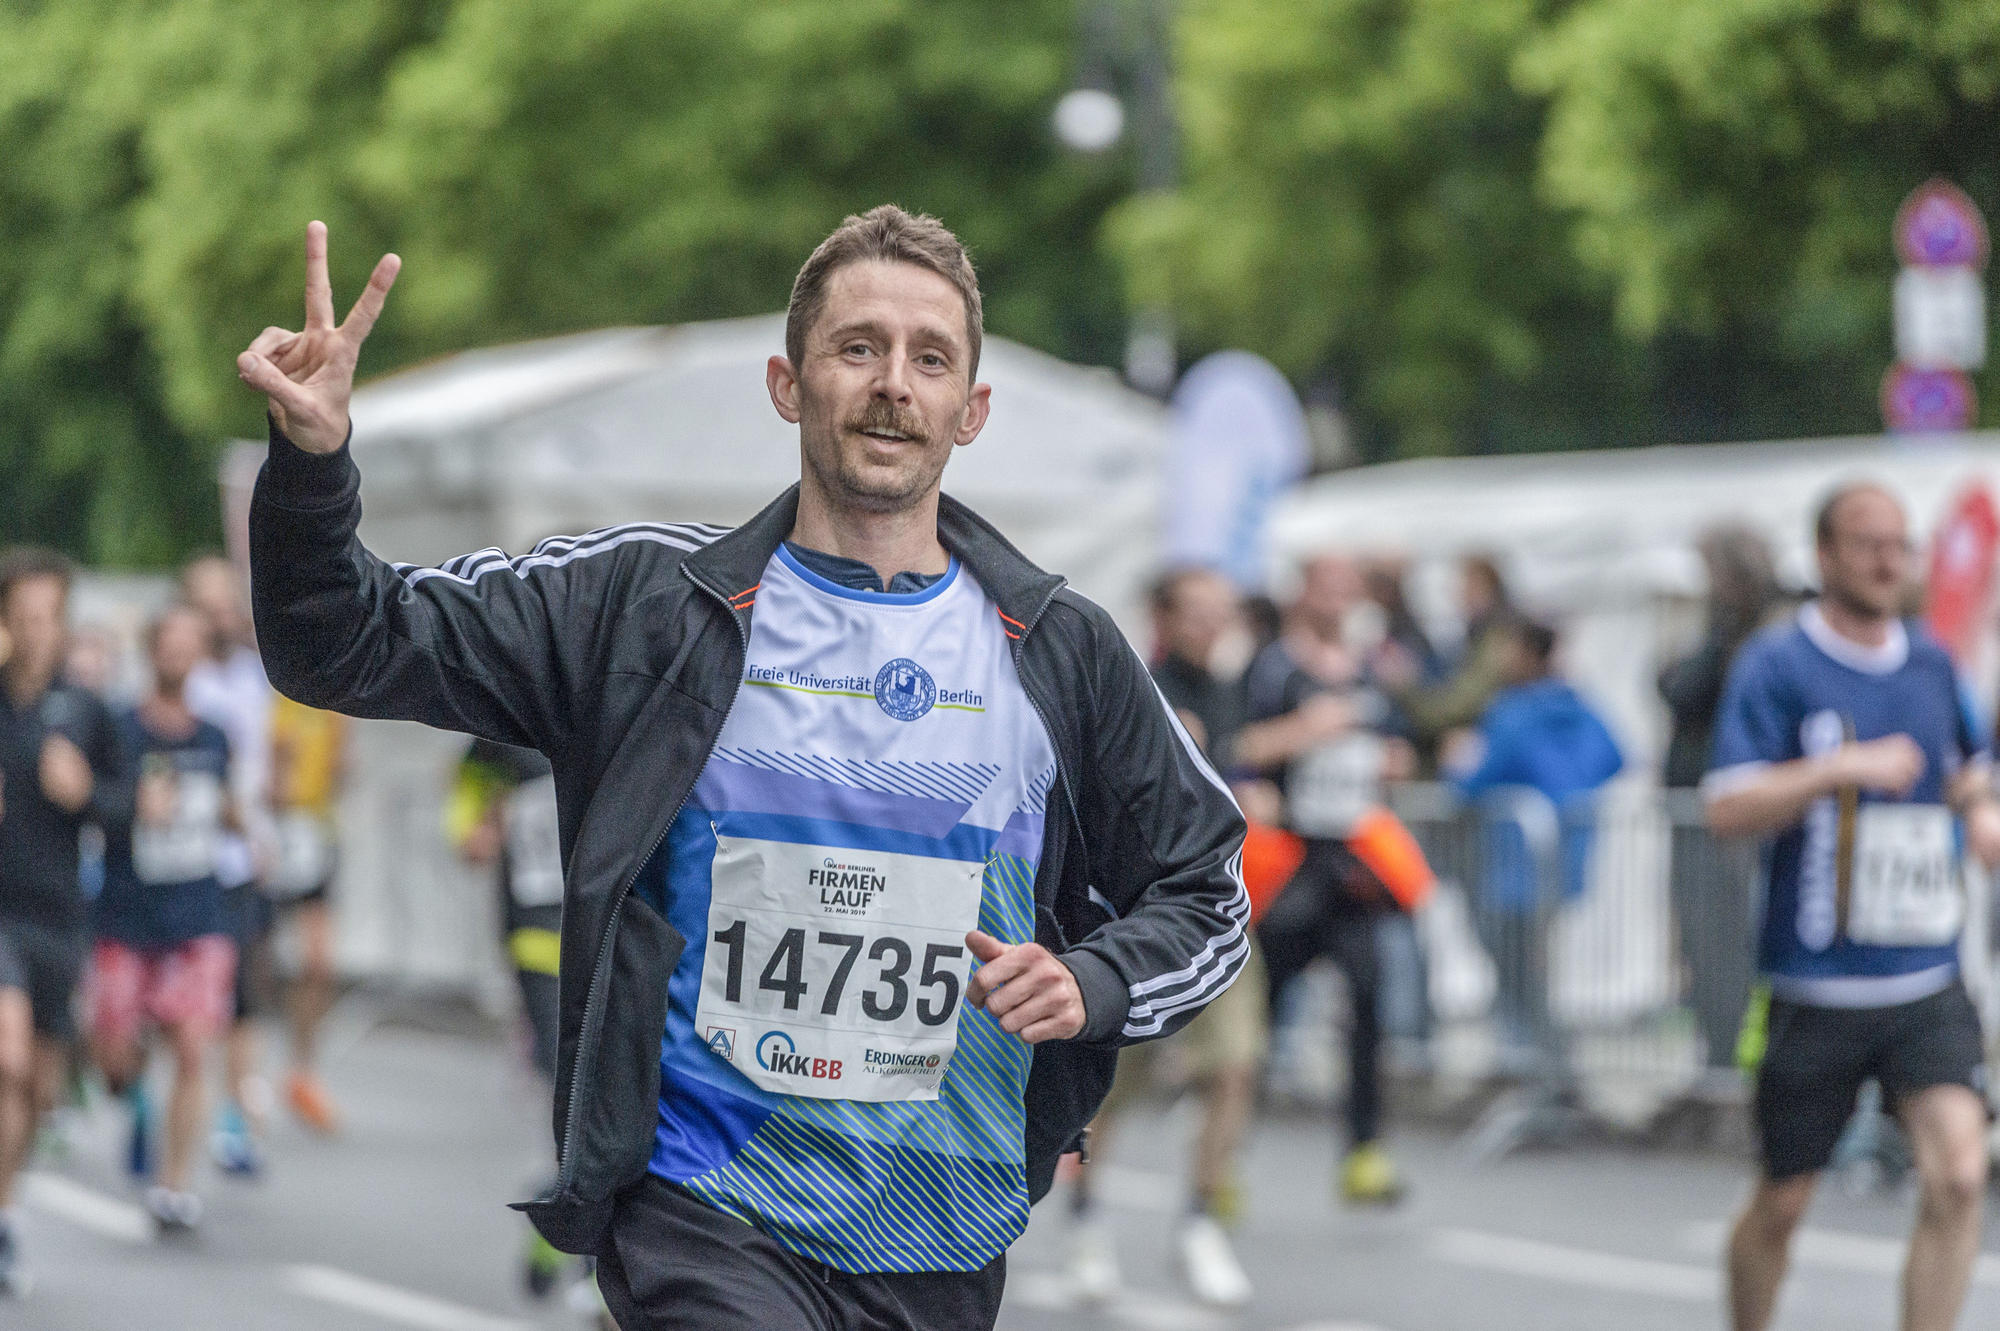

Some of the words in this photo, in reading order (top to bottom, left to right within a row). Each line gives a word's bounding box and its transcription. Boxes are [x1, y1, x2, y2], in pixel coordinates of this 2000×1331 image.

[749, 664, 784, 682] Freie
[789, 670, 871, 692] Universität
[940, 689, 982, 706] Berlin
[809, 869, 886, 892] FIRMEN
[820, 888, 872, 908] LAUF
[714, 919, 964, 1026] 14735
[864, 1048, 926, 1068] ERDINGER
